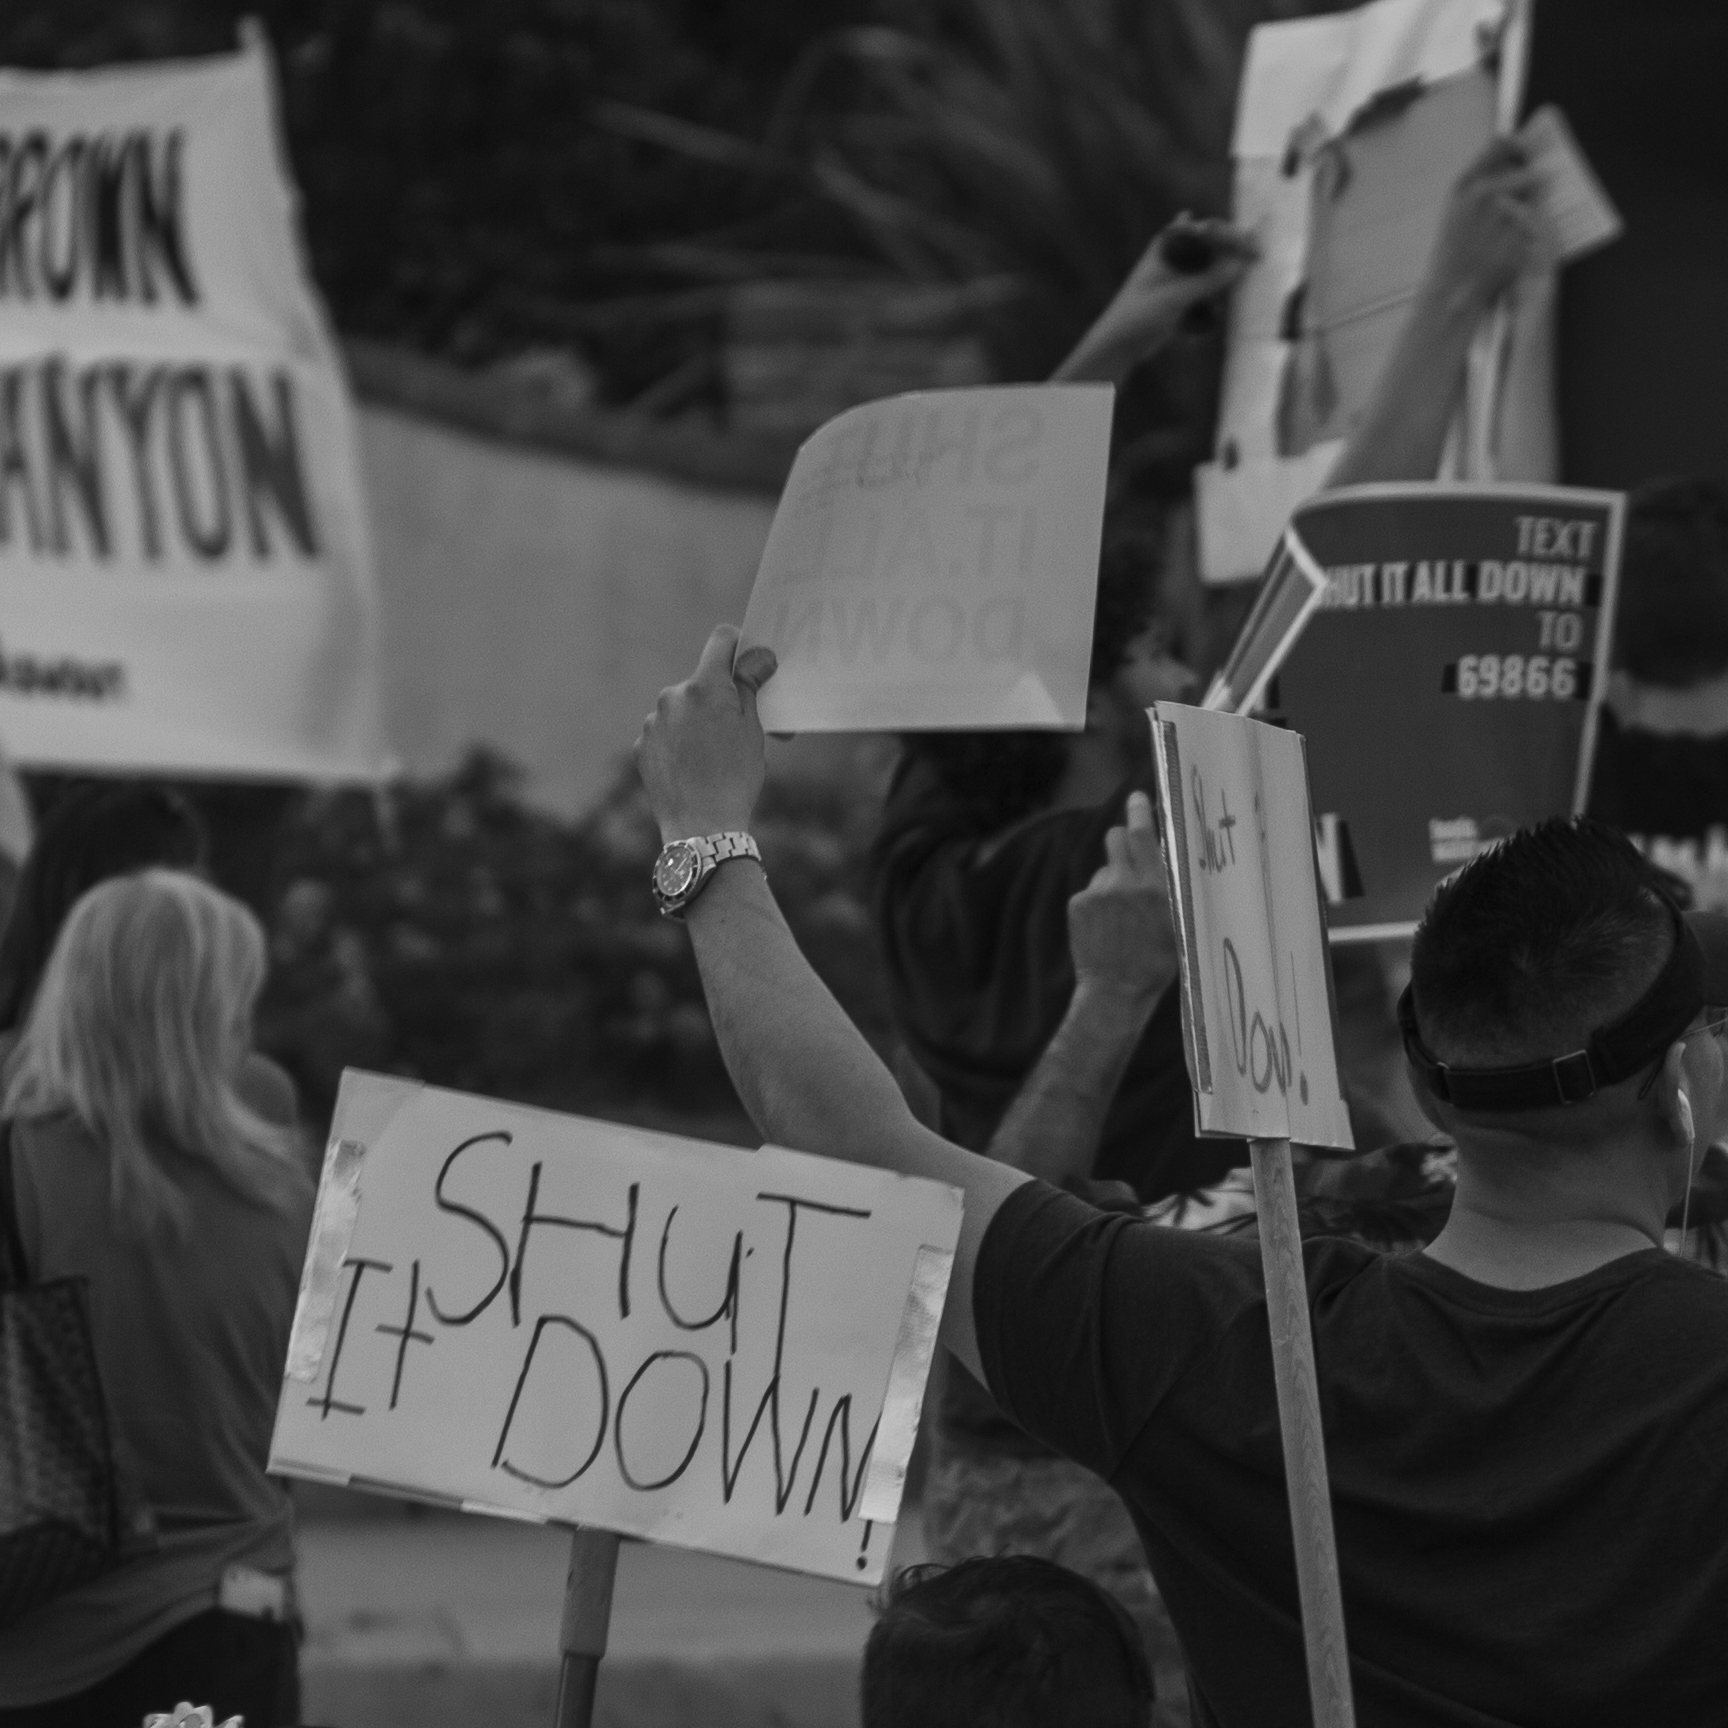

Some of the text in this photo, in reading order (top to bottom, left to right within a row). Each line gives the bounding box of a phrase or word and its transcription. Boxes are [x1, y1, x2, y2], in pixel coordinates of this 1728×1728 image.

[1515, 515, 1599, 560] TEXT
[1380, 561, 1411, 608] IT
[1411, 559, 1472, 606] ALL
[1476, 559, 1587, 607] DOWN
[1536, 610, 1584, 651] TO
[1457, 653, 1577, 700] 69866
[427, 1131, 872, 1378] SHUT
[491, 1315, 883, 1570] DOWN!
